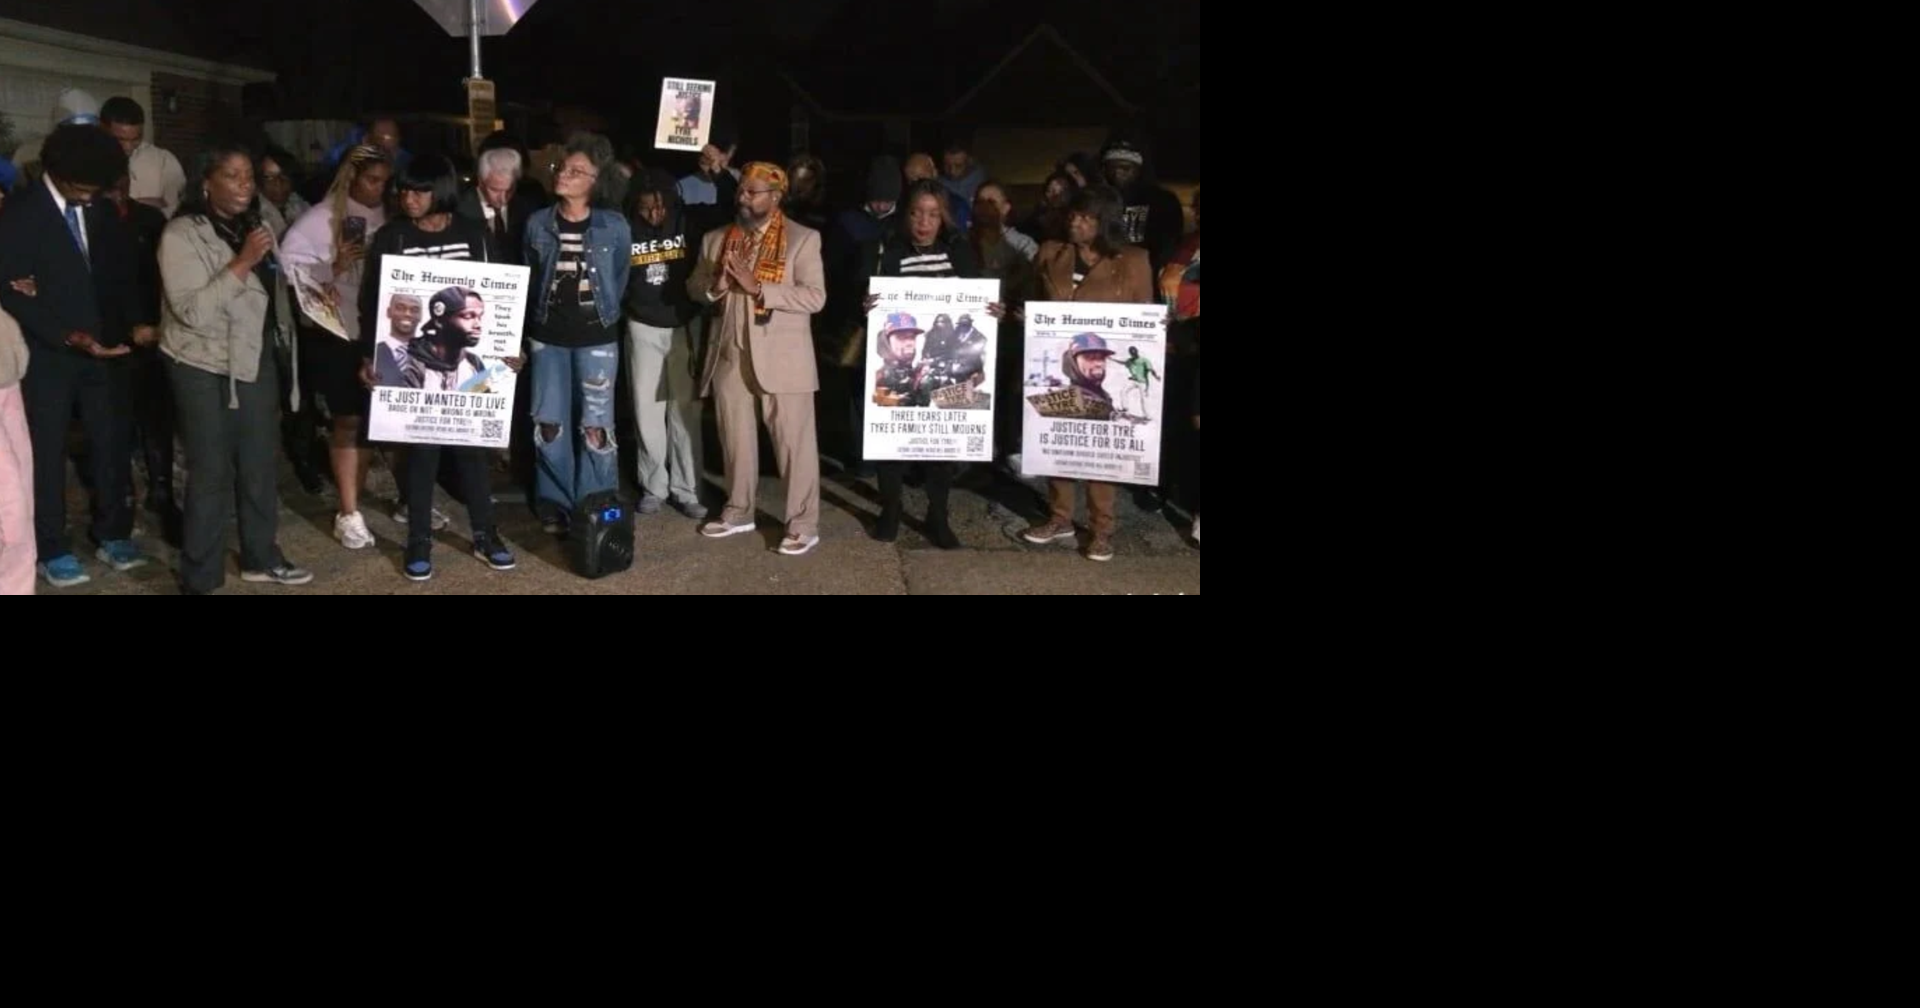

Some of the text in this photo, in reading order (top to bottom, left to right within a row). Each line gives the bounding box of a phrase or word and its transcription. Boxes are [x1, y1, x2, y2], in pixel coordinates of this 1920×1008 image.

[667, 81, 712, 92] STILL SEEKING
[675, 125, 691, 135] TYRE
[668, 135, 698, 145] NICHOLS
[631, 234, 687, 255] REE-901
[391, 269, 517, 290] The Heavenly Times
[1034, 314, 1156, 329] The Heavenly Times
[379, 389, 507, 410] HE JUST WANTED TO LIVE
[388, 404, 408, 413] BADGE
[409, 405, 418, 413] OR
[419, 406, 433, 414] NOT
[440, 407, 464, 416] WRONG
[472, 409, 496, 418] WRONG
[891, 411, 967, 422] THREE YEARS LATER
[413, 416, 437, 424] JUSTICE
[439, 417, 451, 425] FOR
[897, 423, 926, 434] FAMILY
[928, 424, 949, 434] STILL
[952, 424, 987, 435] MOURNS
[1050, 421, 1135, 438] JUSTICE FOR TYRE
[1039, 432, 1146, 452] IS JUSTICE FOR US ALL
